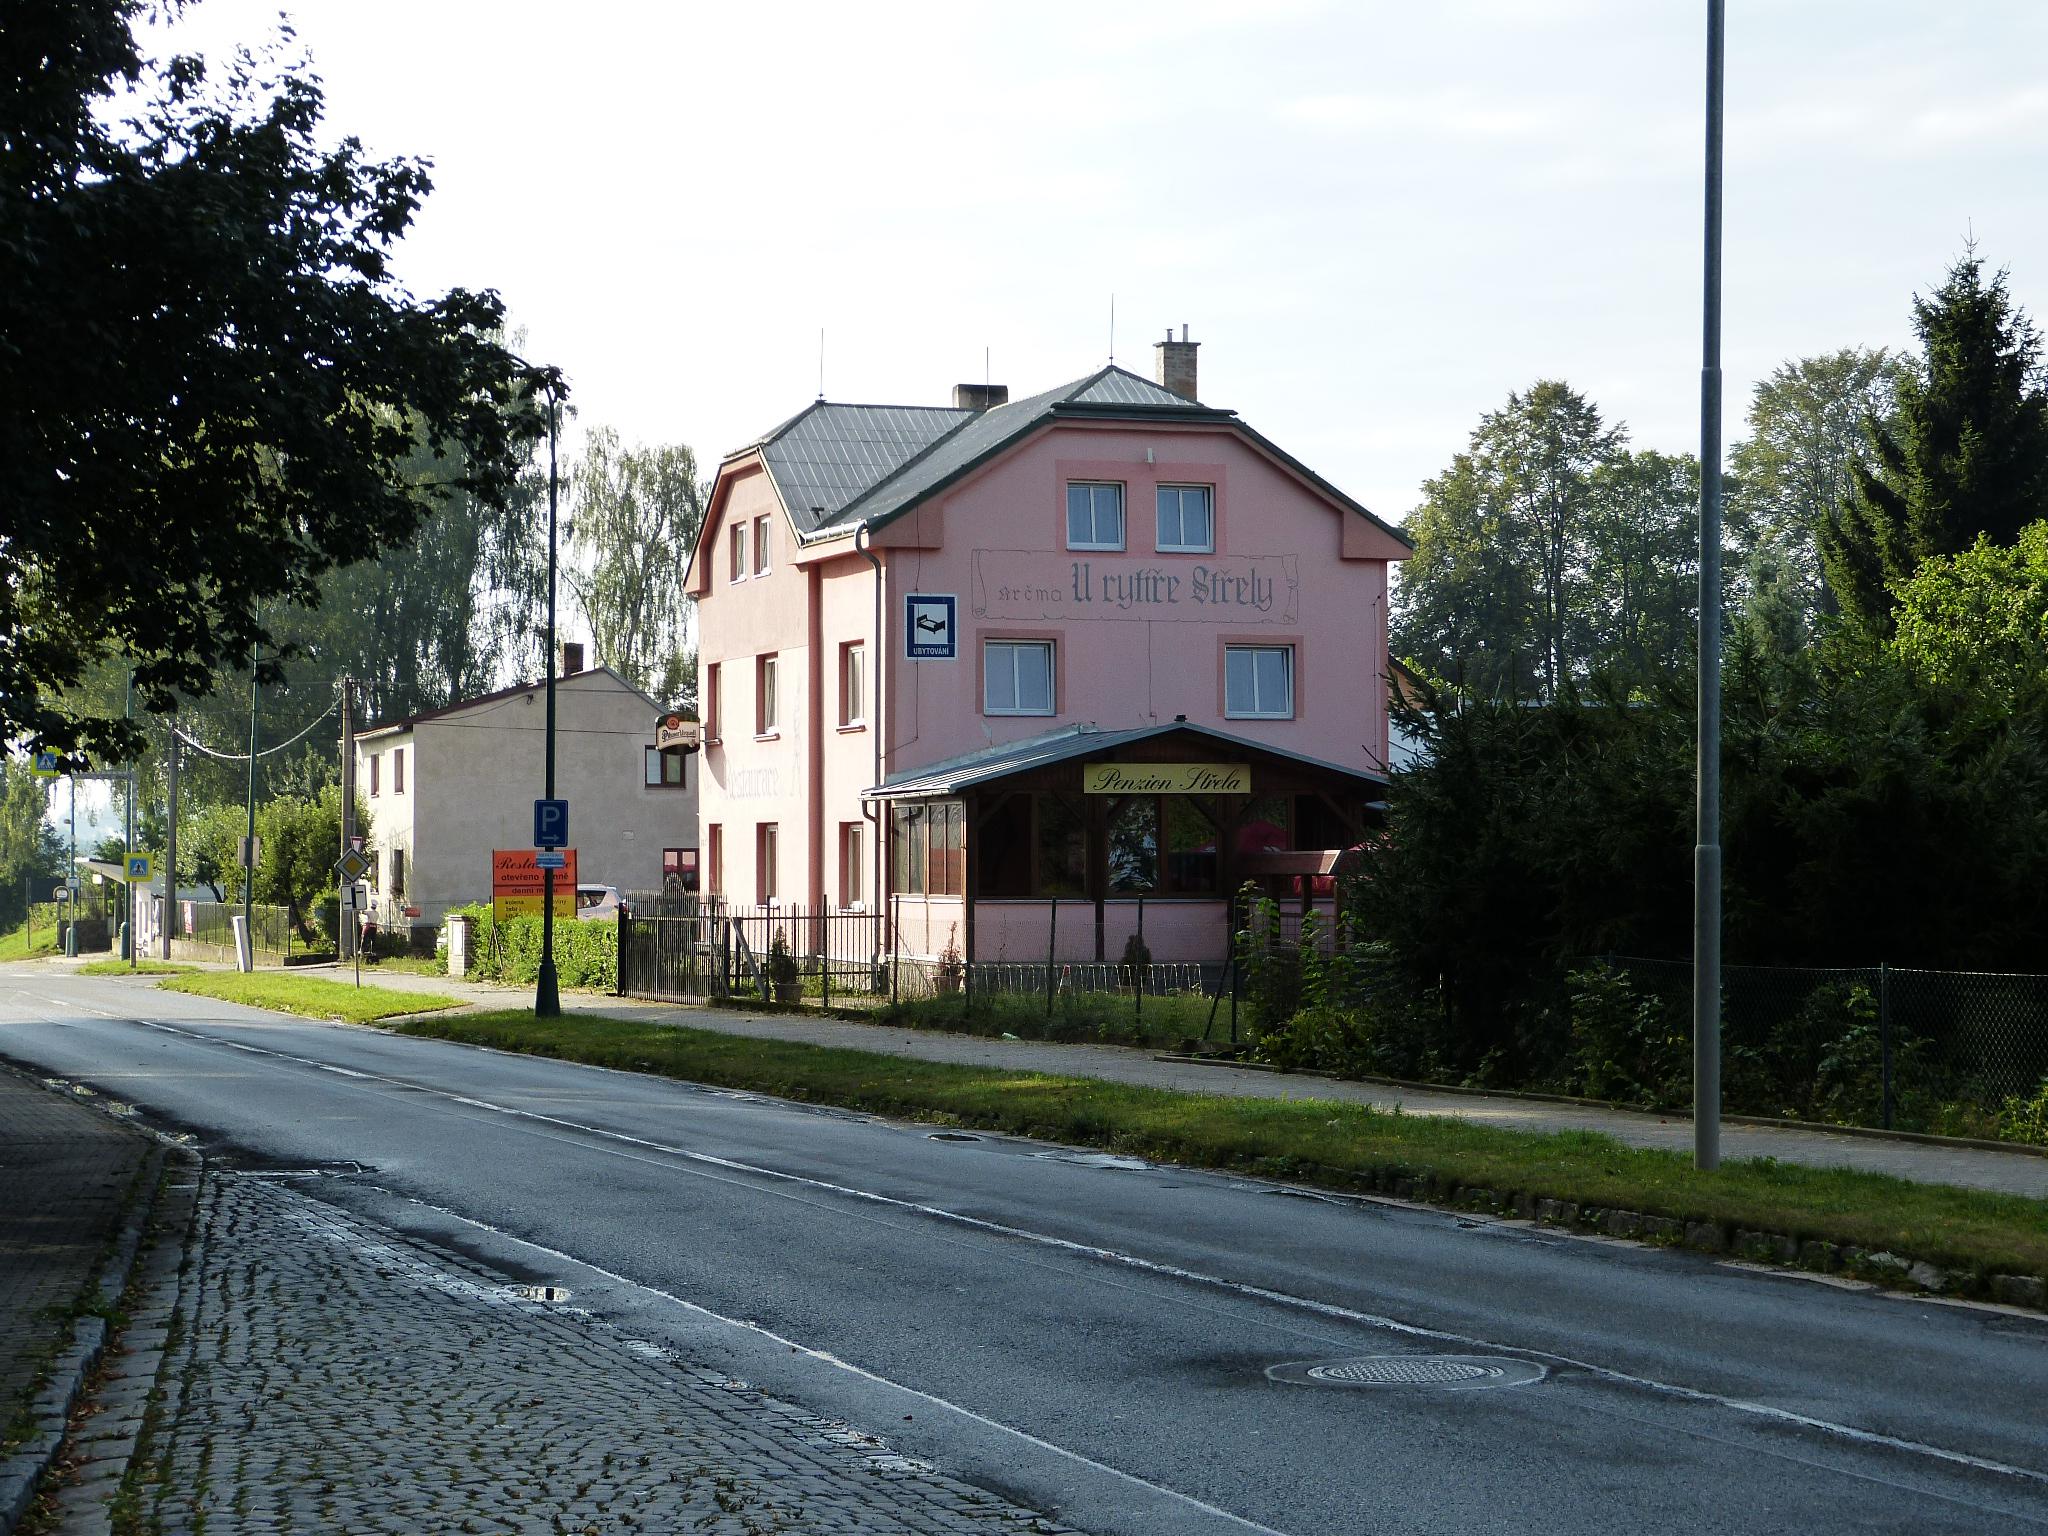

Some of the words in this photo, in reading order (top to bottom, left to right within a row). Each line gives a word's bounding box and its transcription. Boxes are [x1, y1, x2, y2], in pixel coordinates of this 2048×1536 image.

[1071, 561, 1093, 603] U
[1102, 567, 1181, 610] rytíře
[1191, 565, 1273, 612] Střely
[1093, 767, 1172, 791] Penzion
[1179, 767, 1241, 791] Střela
[542, 805, 561, 832] P
